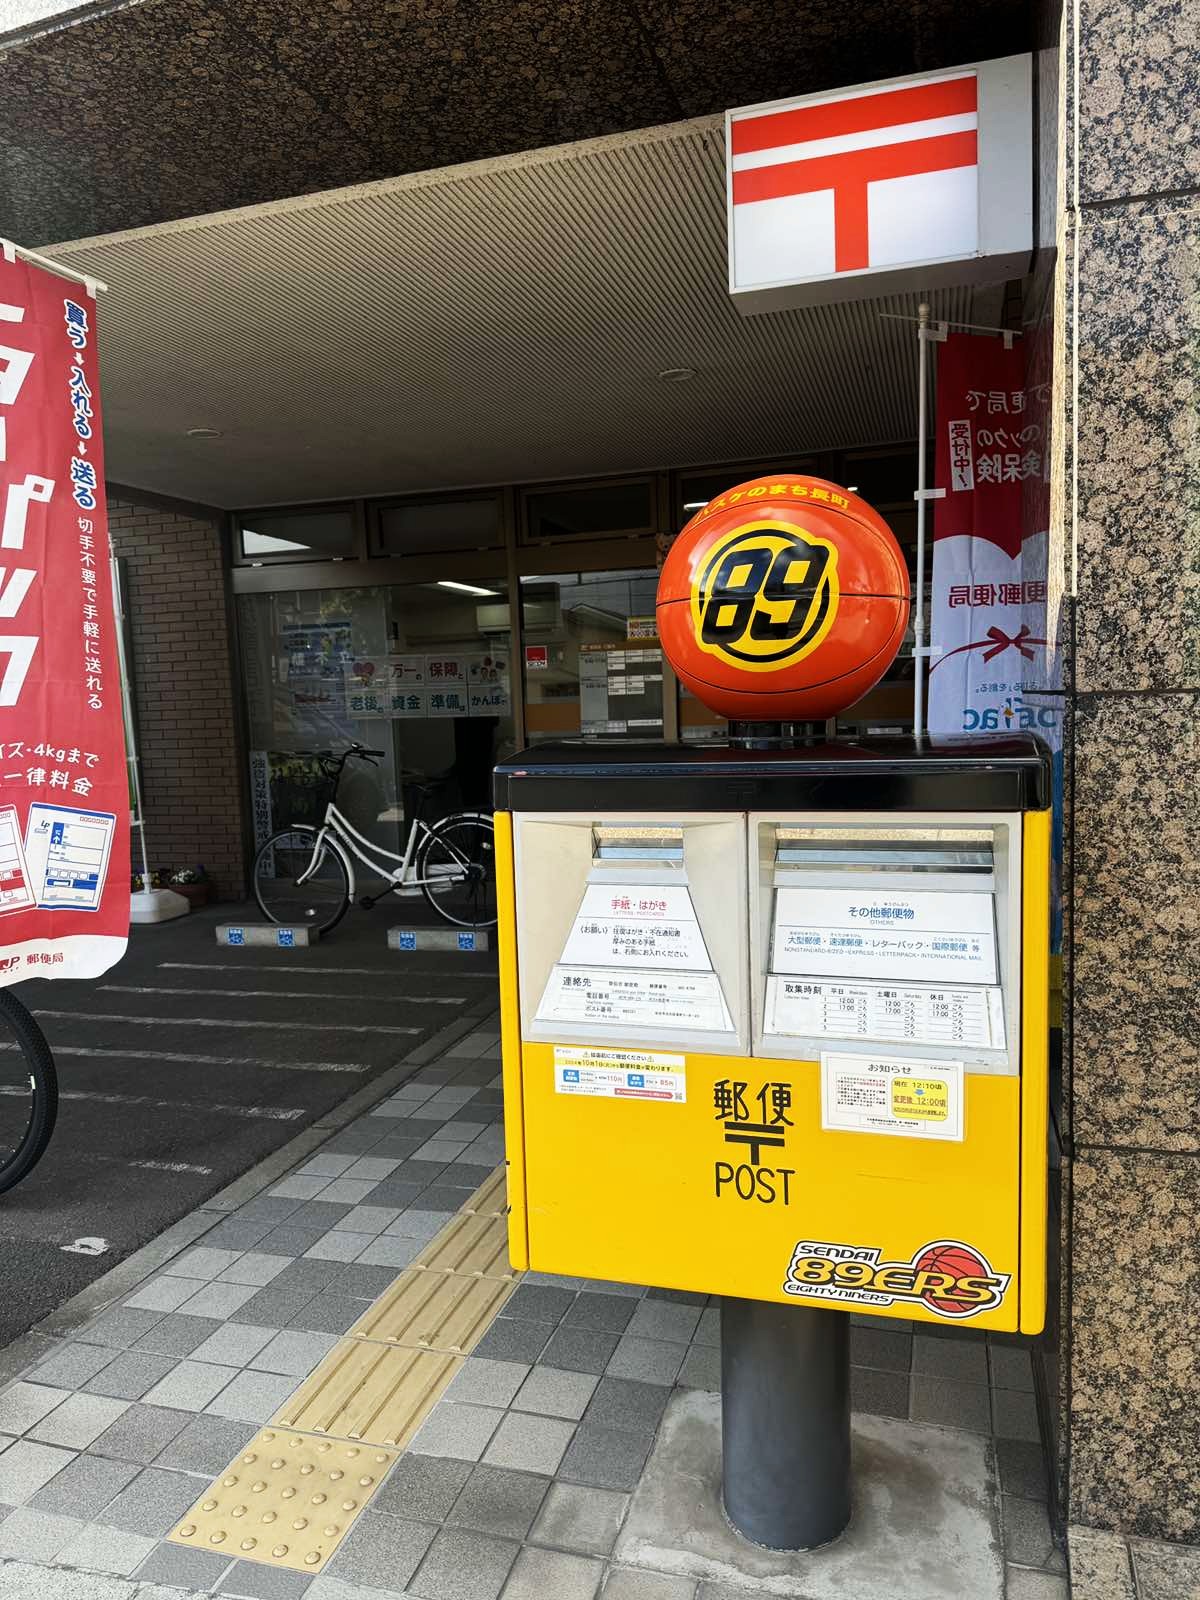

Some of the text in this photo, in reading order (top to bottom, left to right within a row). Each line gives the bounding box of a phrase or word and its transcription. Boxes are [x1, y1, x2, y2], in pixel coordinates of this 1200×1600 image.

[64, 300, 96, 509] 買う 入れる 送る
[78, 517, 103, 710] 切手不要で手軽に送れる
[702, 545, 829, 643] 89
[848, 906, 915, 920] その他郵便物
[562, 976, 591, 987] 連絡先
[785, 984, 822, 995] 取集時刻
[831, 987, 844, 995] 平日
[930, 993, 944, 1001] 休日
[867, 1063, 912, 1074] お知らせ
[714, 1079, 795, 1126] 郵便
[715, 1161, 796, 1206] POST
[799, 1245, 875, 1262] SENDAI
[792, 1257, 1003, 1304] 89ERS
